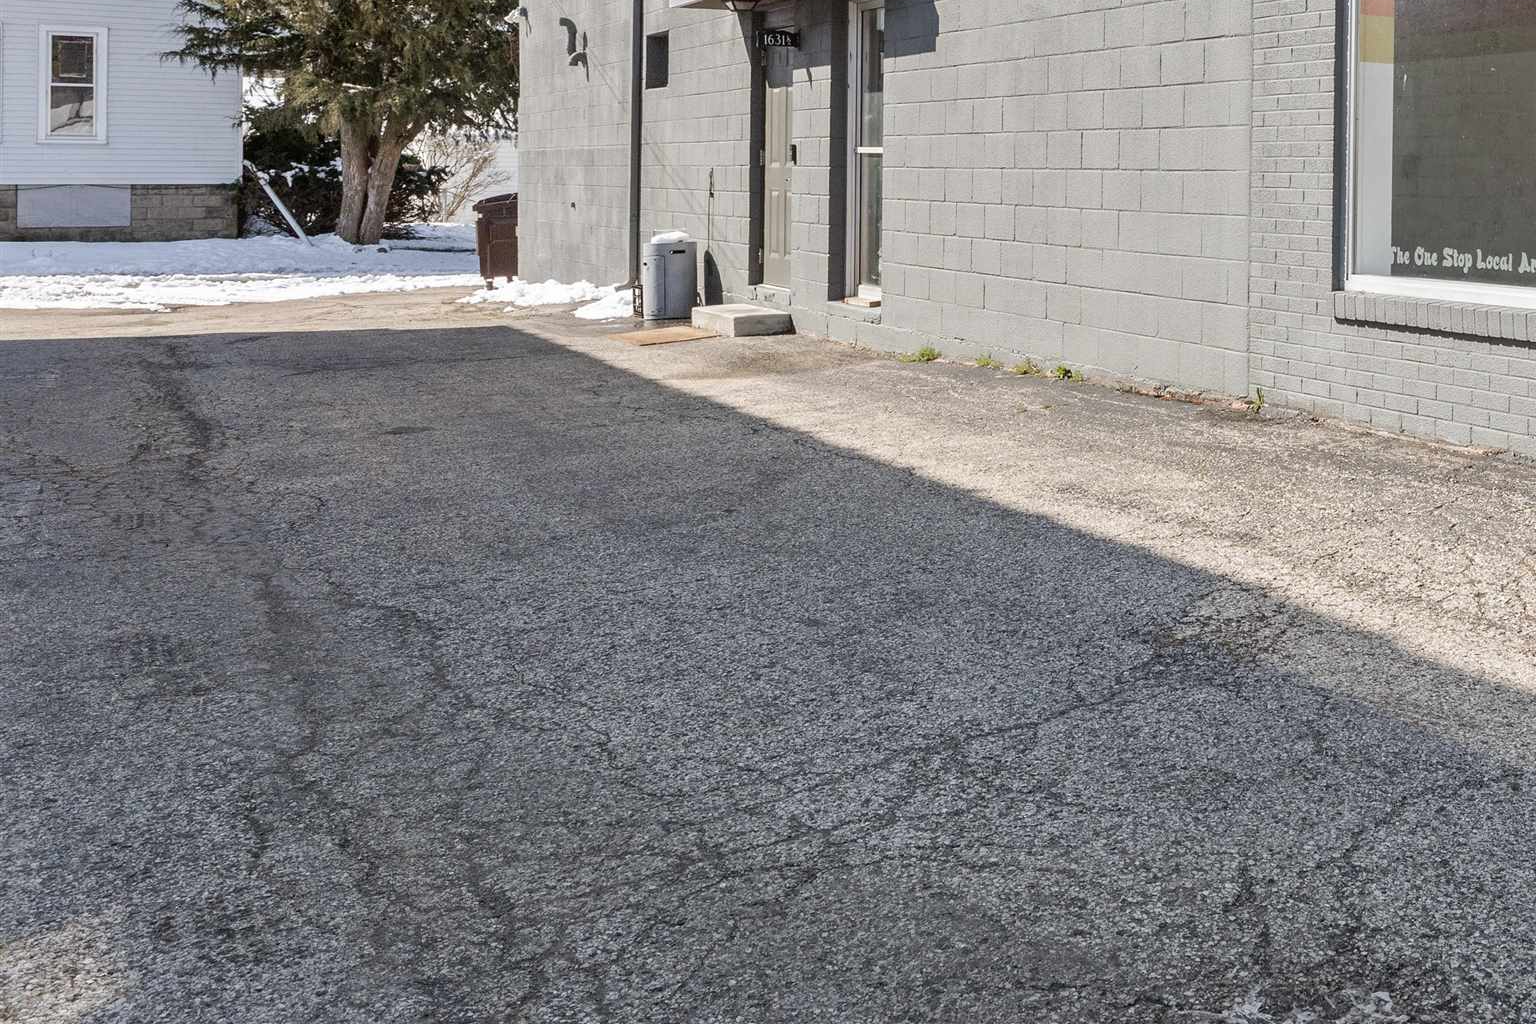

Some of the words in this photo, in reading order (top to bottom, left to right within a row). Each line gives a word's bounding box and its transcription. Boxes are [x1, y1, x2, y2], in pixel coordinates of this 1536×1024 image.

[1414, 246, 1438, 266] One
[1442, 247, 1473, 274] Stop
[1476, 249, 1513, 272] Local
